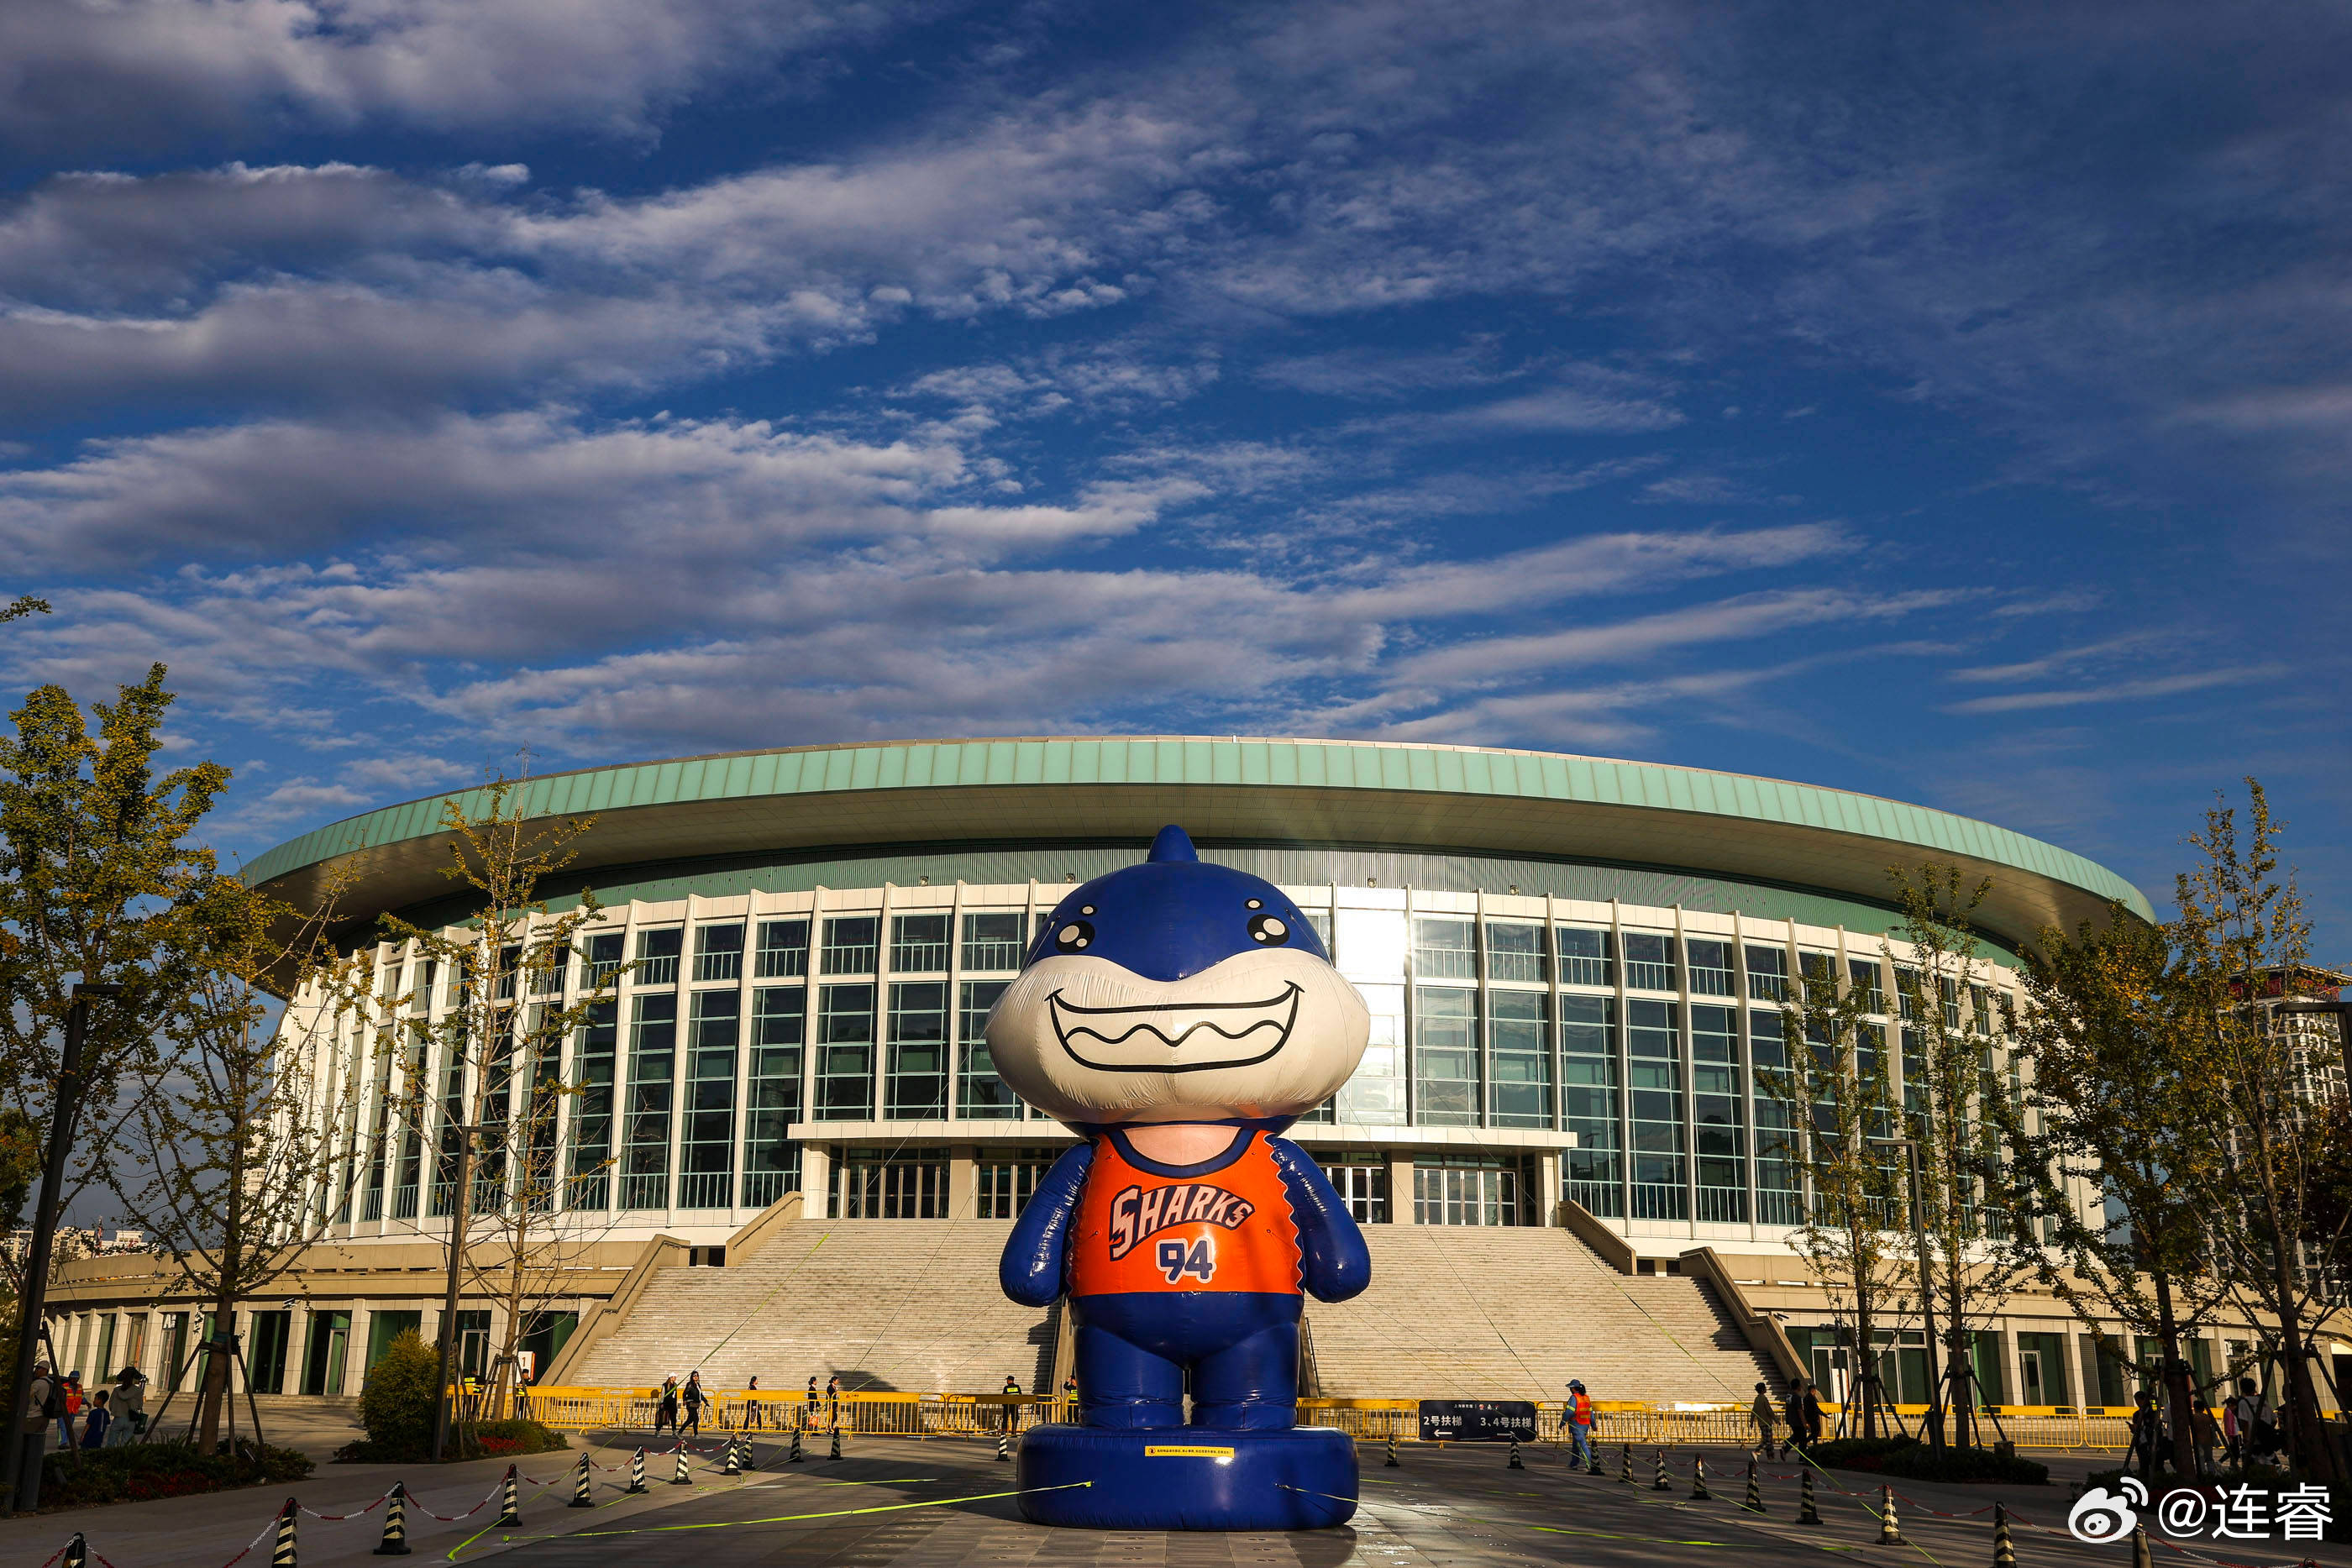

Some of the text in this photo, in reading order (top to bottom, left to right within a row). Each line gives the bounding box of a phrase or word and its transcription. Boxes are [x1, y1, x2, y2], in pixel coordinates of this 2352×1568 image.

[1109, 1184, 1255, 1261] SHARKS
[1156, 1235, 1216, 1284] 94
[163, 1314, 171, 1329] A
[1423, 1415, 1462, 1426] 2号扶梯
[1480, 1417, 1532, 1429] 3、4号扶梯
